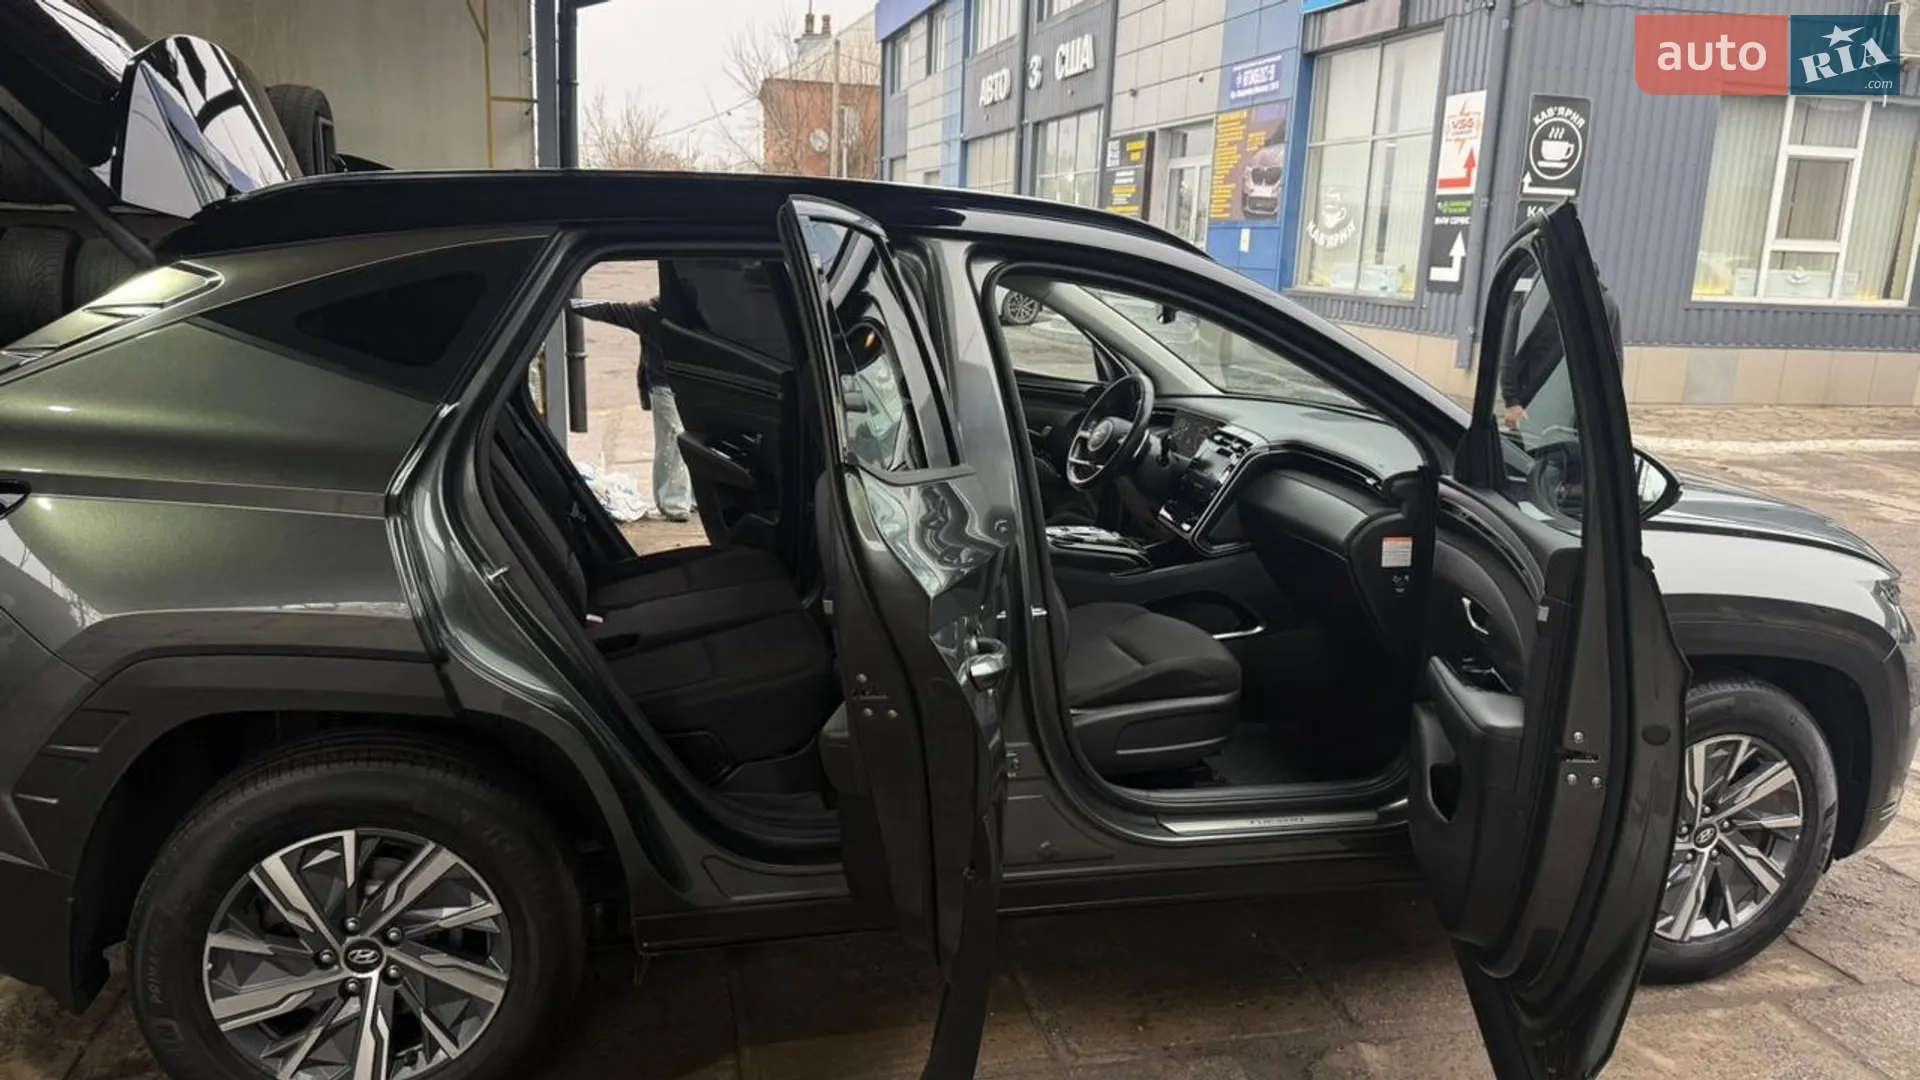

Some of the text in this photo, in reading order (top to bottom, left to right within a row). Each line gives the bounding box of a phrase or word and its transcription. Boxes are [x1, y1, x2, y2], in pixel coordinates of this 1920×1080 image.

[979, 67, 1011, 108] АВТО
[1055, 33, 1095, 80] США
[1533, 106, 1586, 129] КАВ'ЯРНЯ
